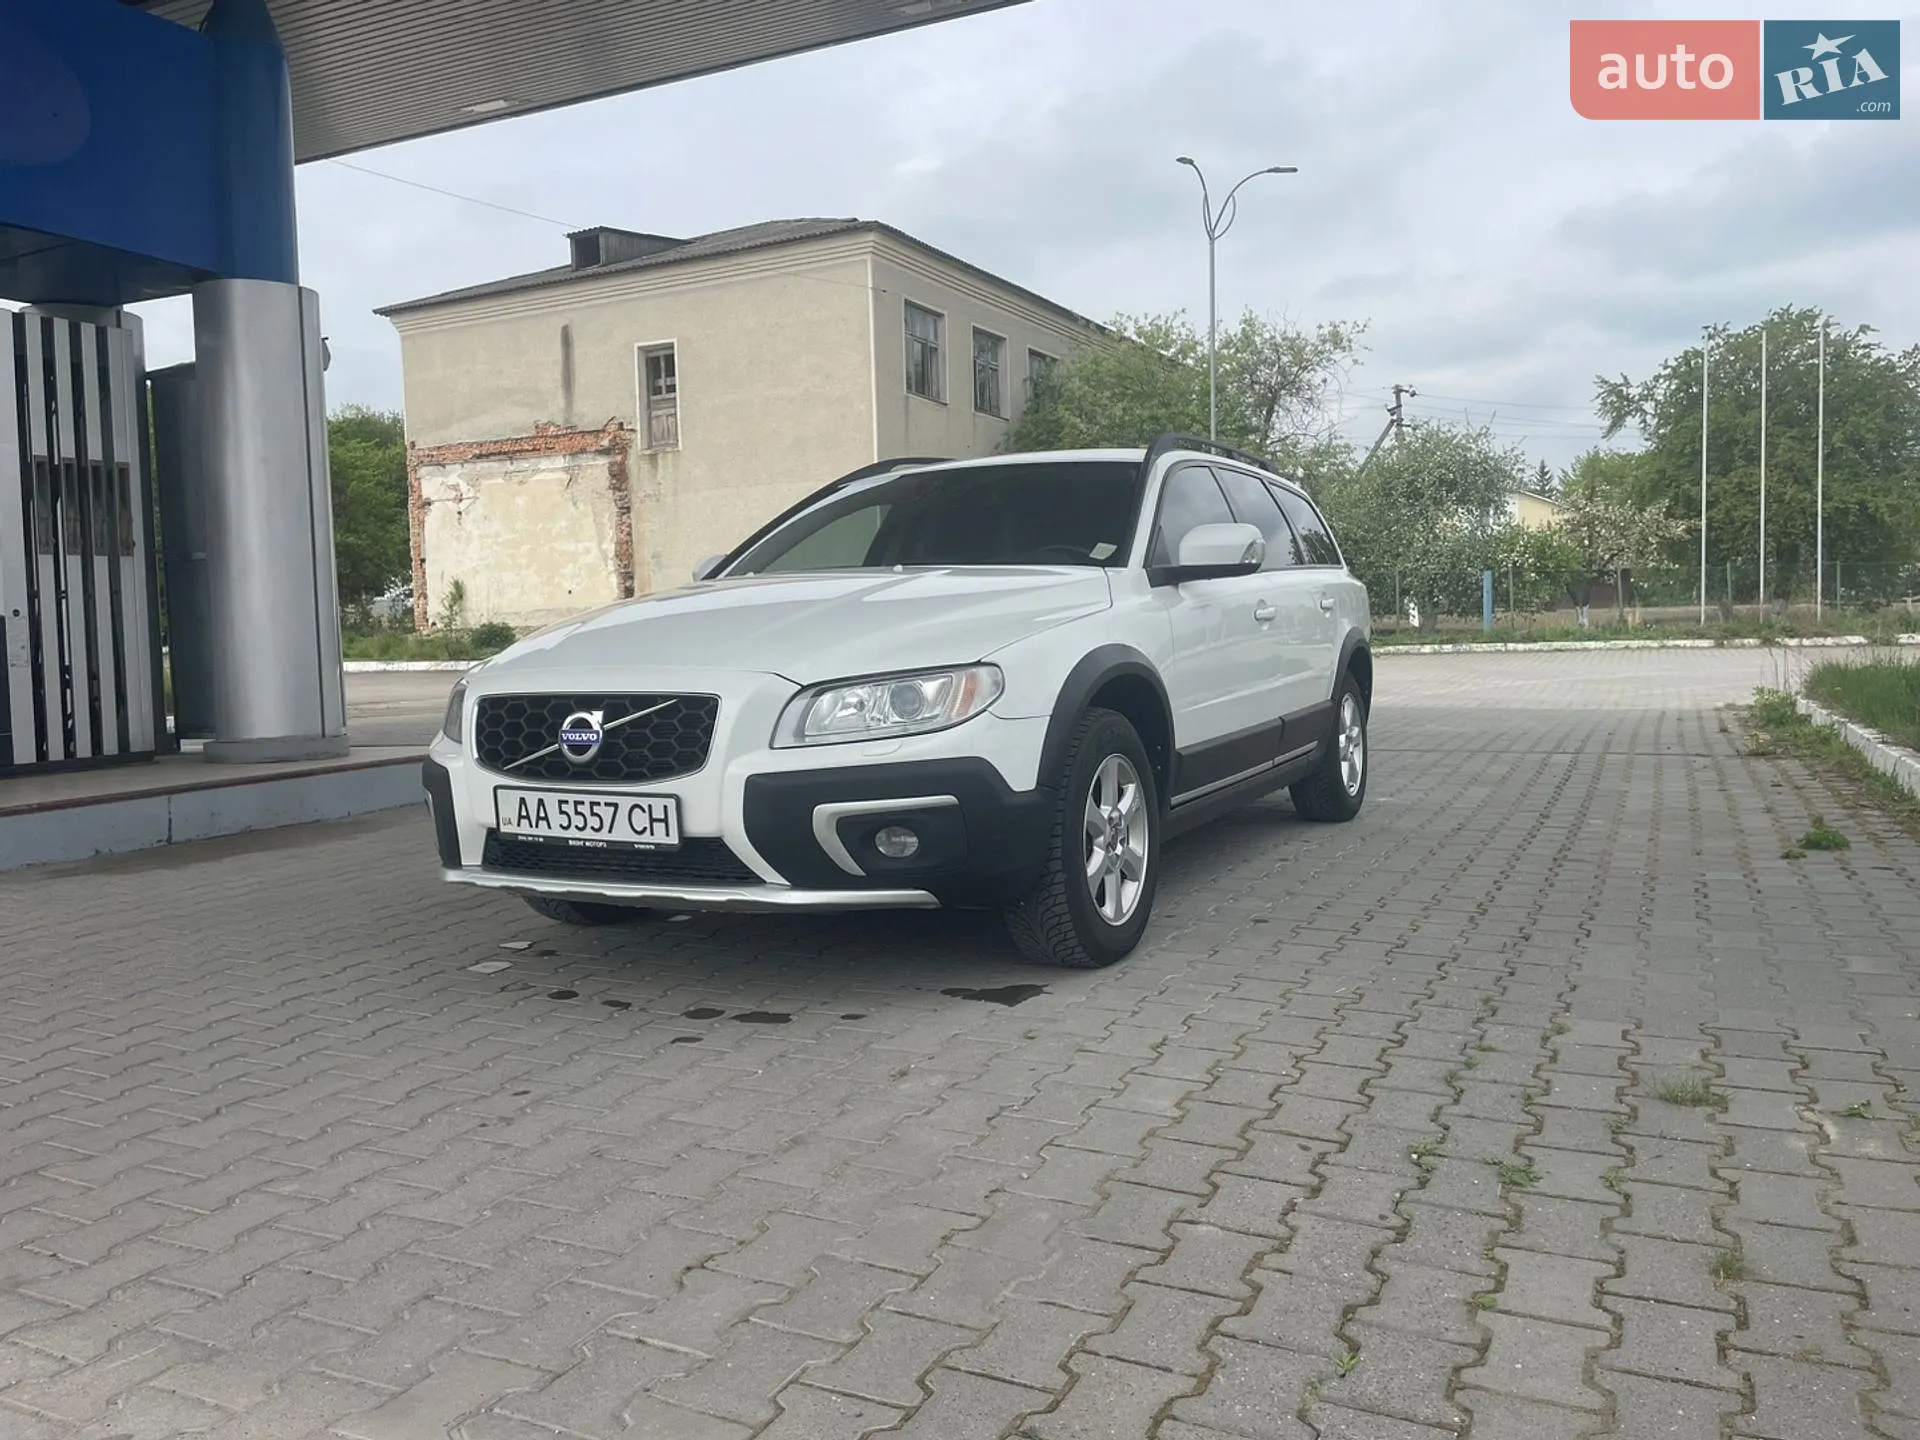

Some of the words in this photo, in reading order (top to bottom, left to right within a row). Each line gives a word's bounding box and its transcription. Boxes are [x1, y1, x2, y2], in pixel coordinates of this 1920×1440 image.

[561, 733, 597, 741] VOLVO
[501, 817, 513, 827] UA
[516, 797, 551, 830] AA
[557, 799, 619, 835] 5557
[627, 803, 670, 837] CH
